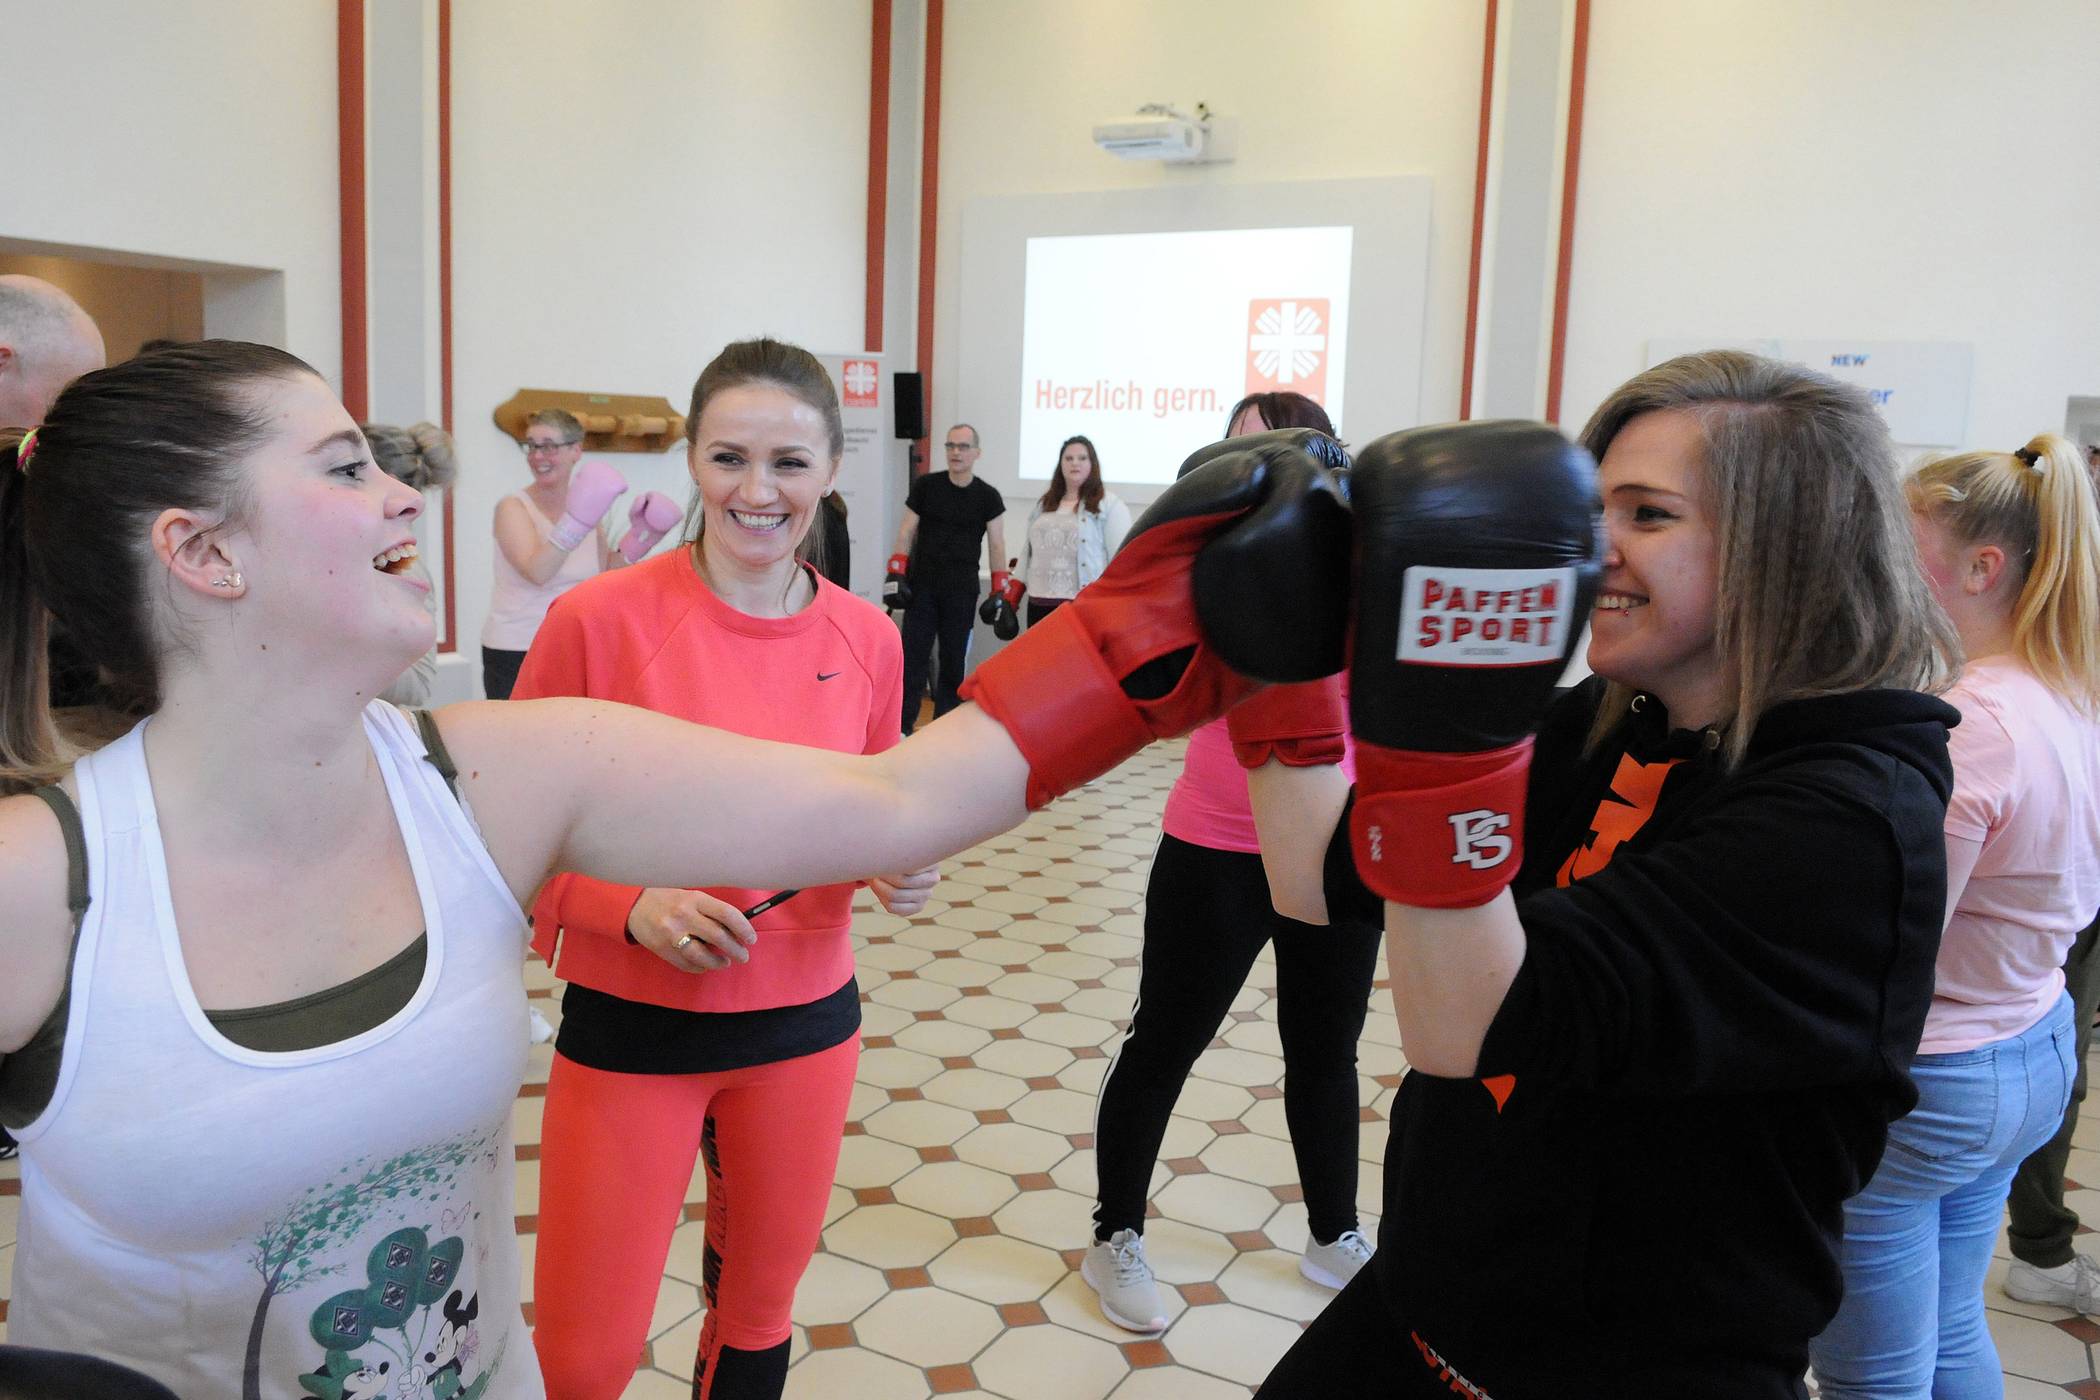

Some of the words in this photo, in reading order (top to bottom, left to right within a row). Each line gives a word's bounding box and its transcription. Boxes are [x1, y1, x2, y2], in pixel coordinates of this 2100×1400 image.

[1831, 354, 1869, 367] NEW
[1034, 378, 1143, 412] Herzlich
[1153, 385, 1225, 418] gern.
[1422, 578, 1560, 613] PAFFEN
[1418, 615, 1557, 648] SPORT
[1448, 808, 1513, 870] PS
